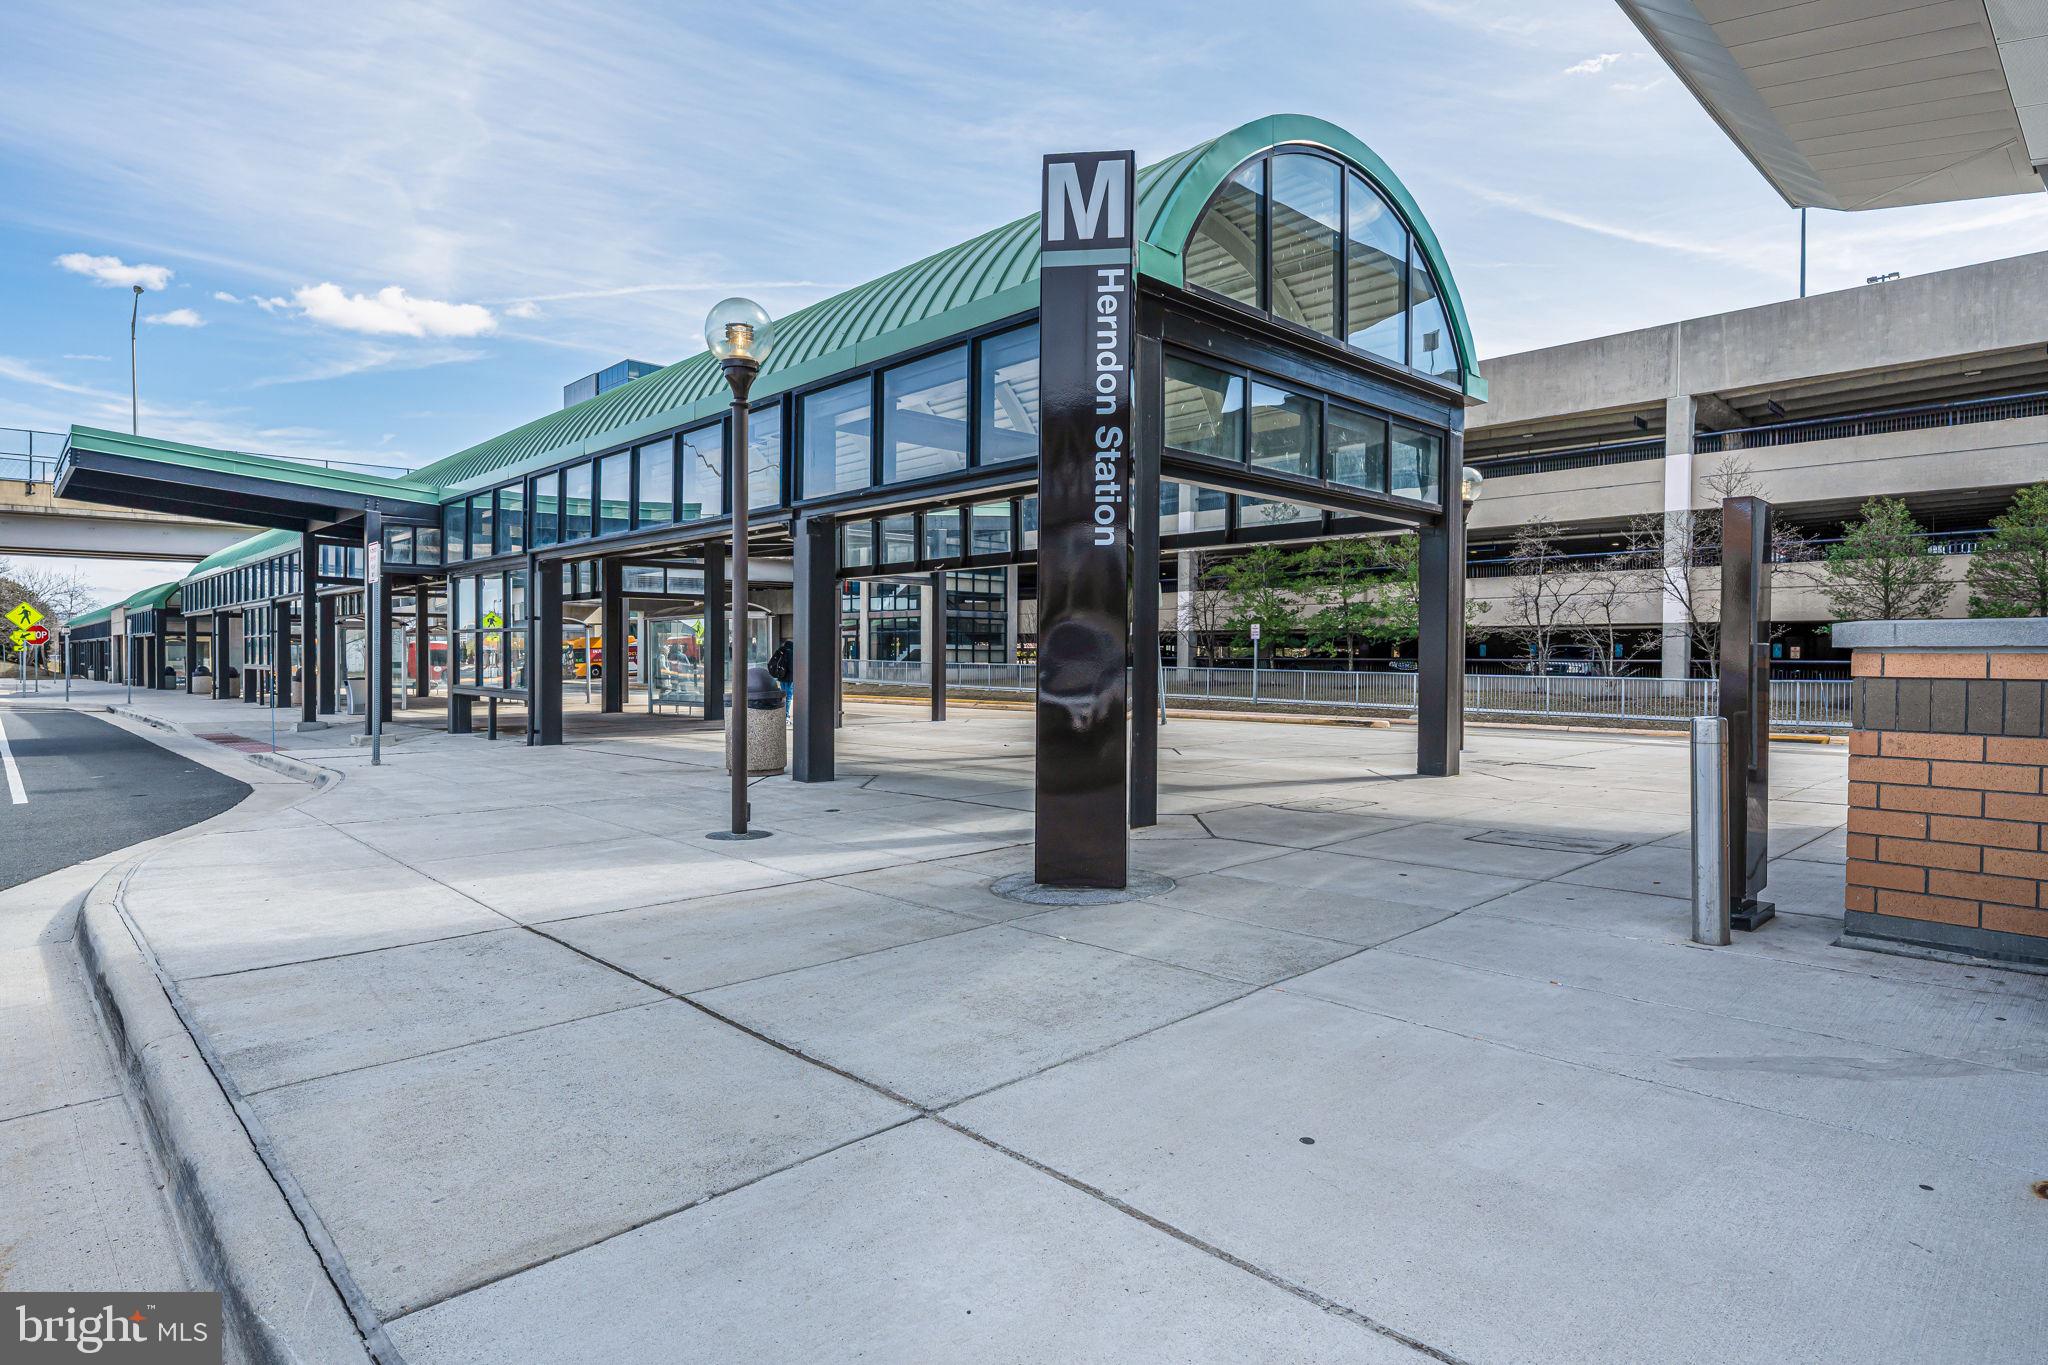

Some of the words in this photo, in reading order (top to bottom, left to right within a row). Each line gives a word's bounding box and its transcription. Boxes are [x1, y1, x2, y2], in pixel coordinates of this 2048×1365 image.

[1048, 160, 1125, 241] M
[1096, 269, 1125, 415] Herndon
[1094, 426, 1124, 546] Station
